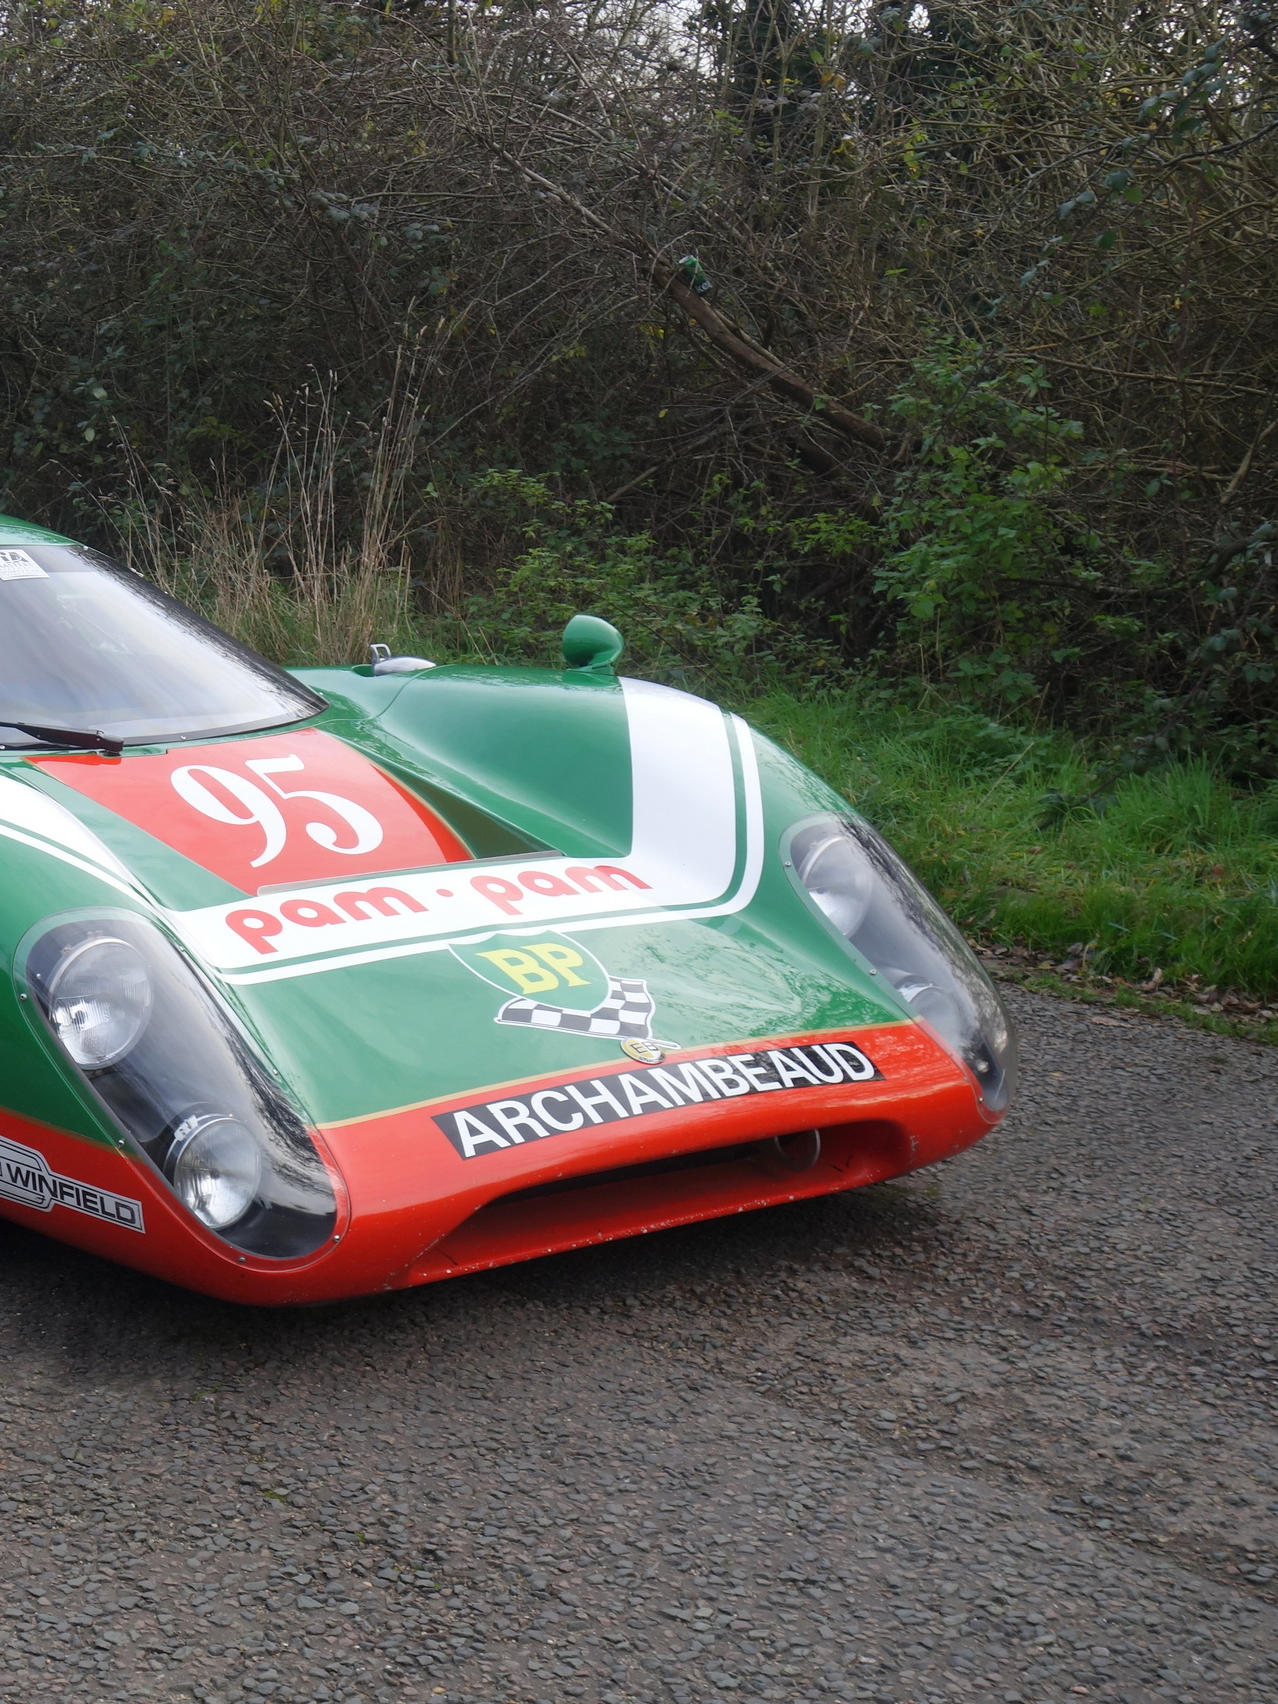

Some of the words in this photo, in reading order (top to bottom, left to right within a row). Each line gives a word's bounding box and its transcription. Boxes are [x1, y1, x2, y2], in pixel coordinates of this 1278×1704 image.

[170, 754, 384, 868] 95
[225, 886, 429, 954] pam
[470, 865, 653, 915] pam
[476, 942, 593, 994] BP
[453, 1043, 876, 1158] ARCHAMBEAUD
[6, 1163, 137, 1224] WINFIELD
